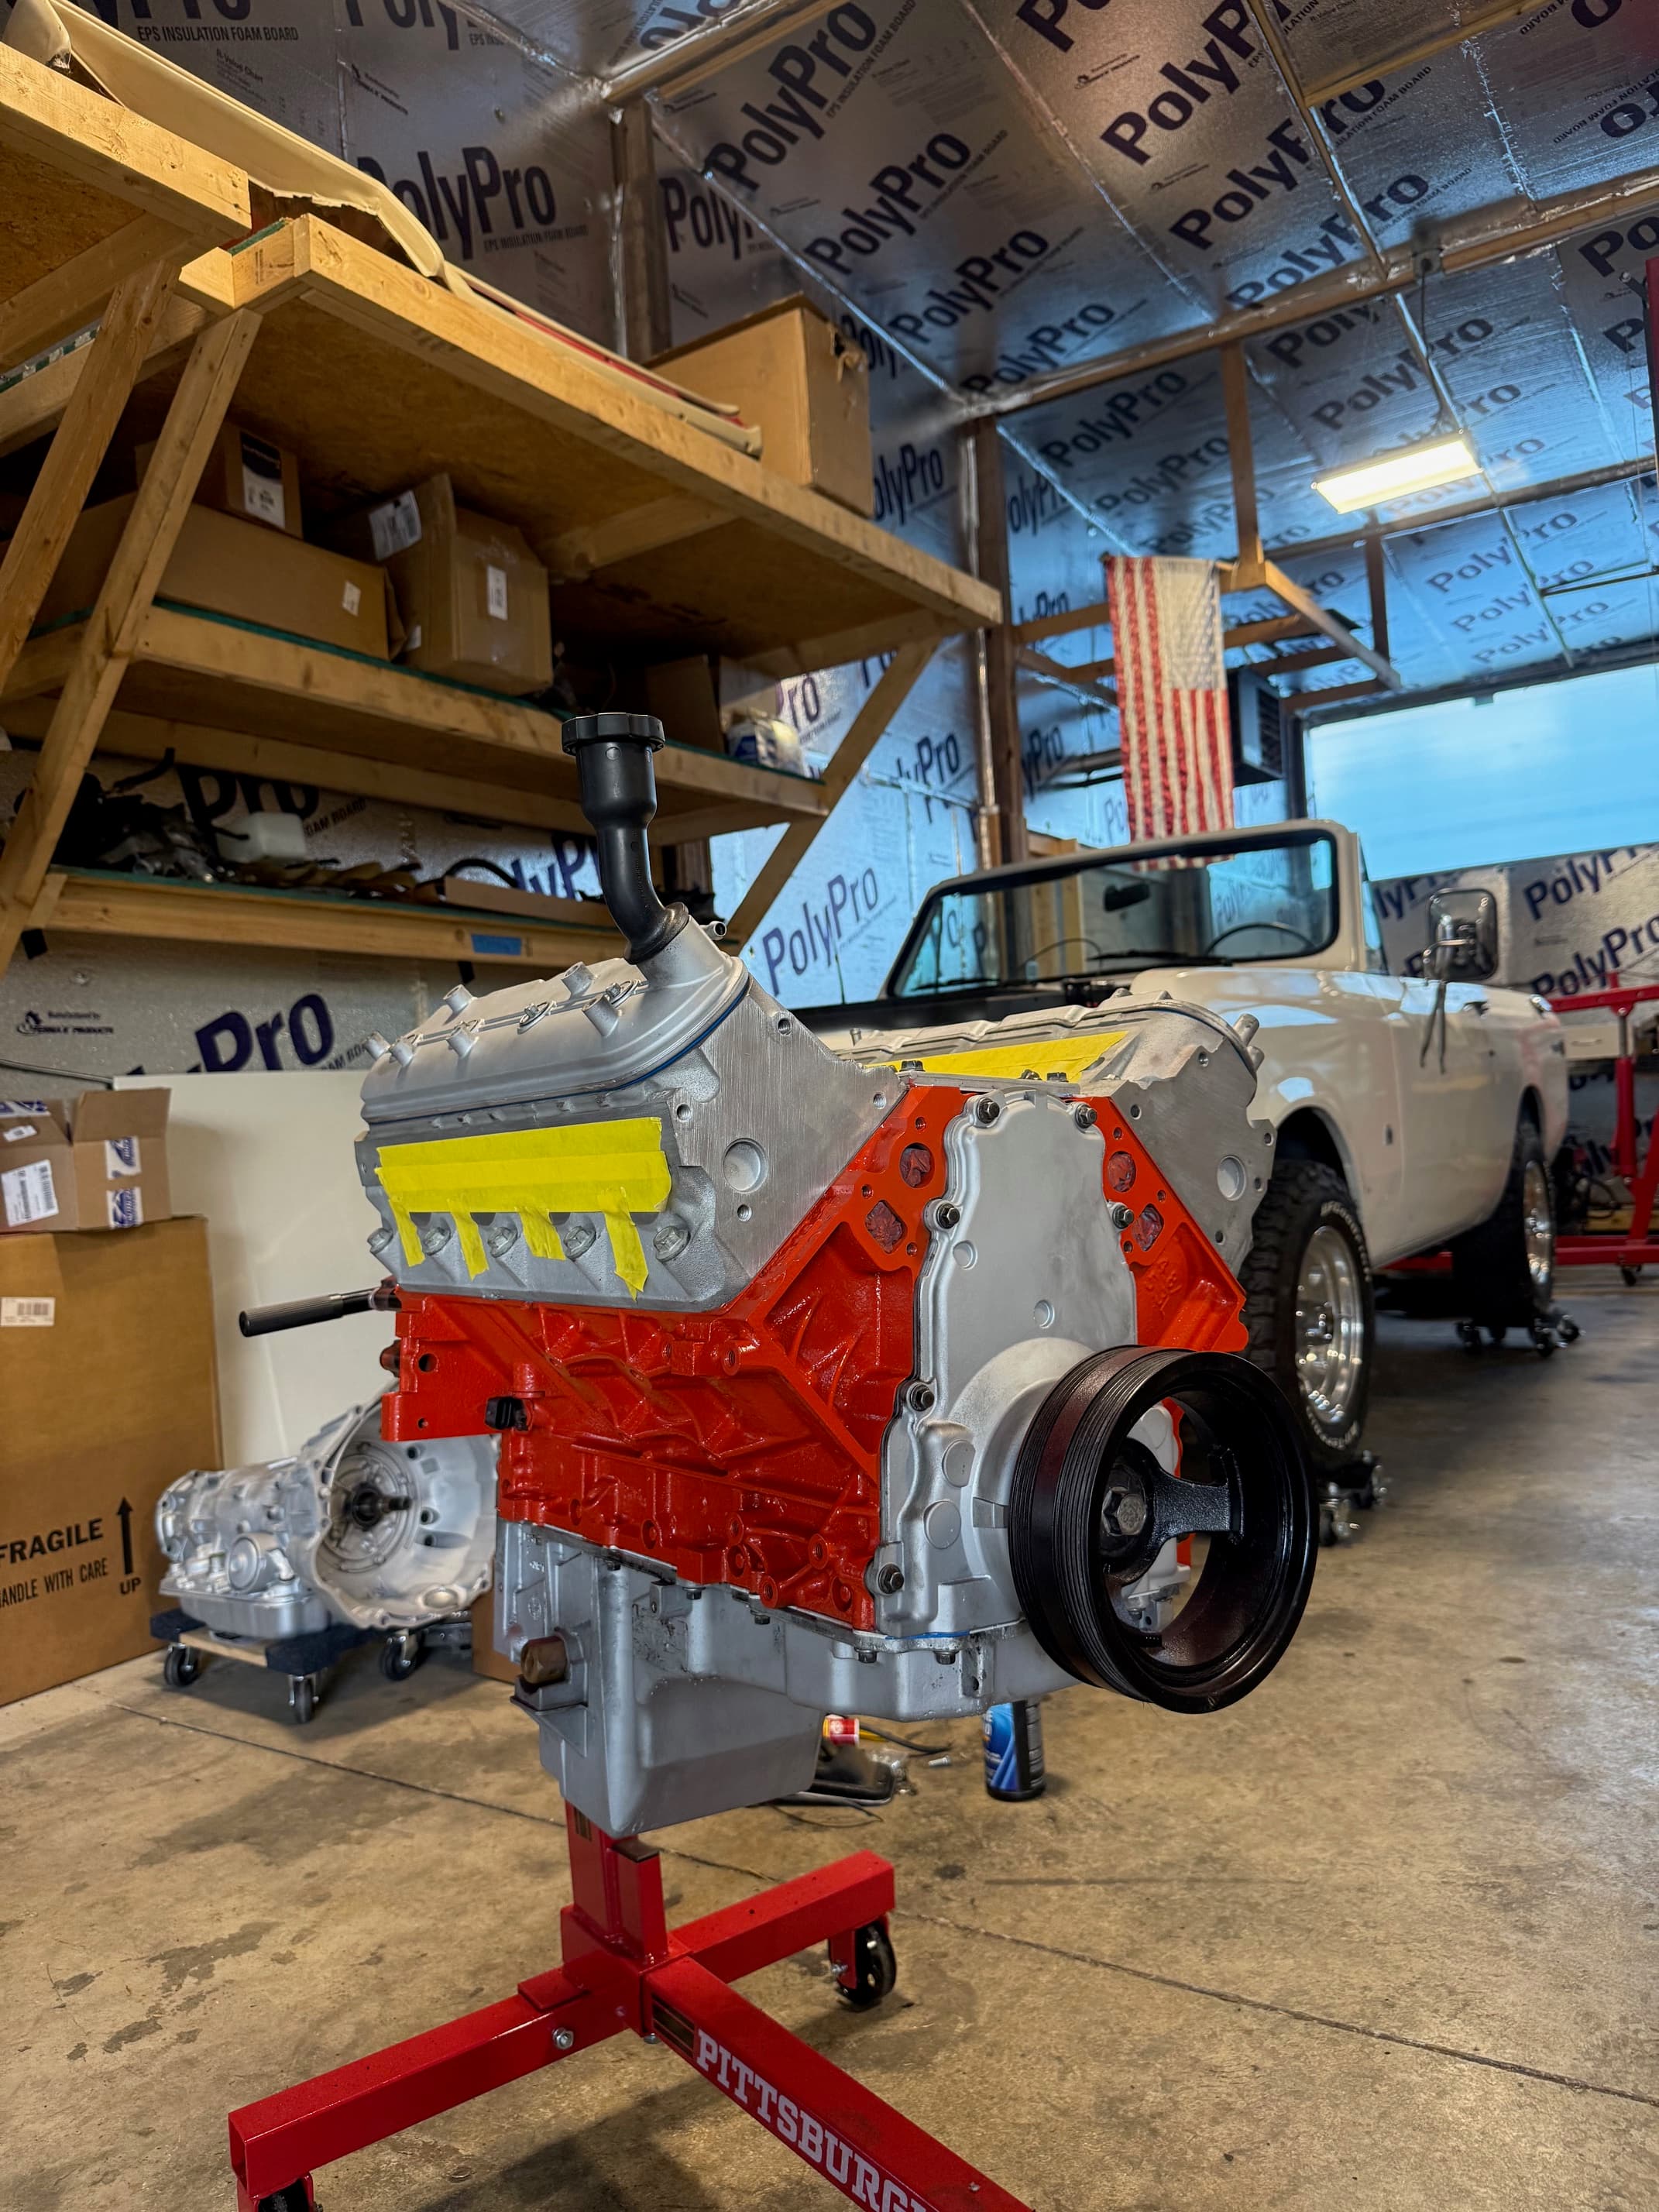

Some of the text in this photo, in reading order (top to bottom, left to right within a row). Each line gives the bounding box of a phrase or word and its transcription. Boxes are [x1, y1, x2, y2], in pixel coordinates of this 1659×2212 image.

[137, 26, 299, 43] EPS INSULATION FOAM BOARD
[704, 2, 876, 191] PolyPro
[803, 133, 971, 275] PolyPro
[890, 230, 1048, 344] PolyPro
[1039, 371, 1187, 468] PolyPro
[762, 867, 878, 998] PolyPro
[0, 1558, 108, 1609] ANDLE WITH CARE
[119, 1577, 142, 1595] UP
[698, 2028, 927, 2212] PITTSBURG
